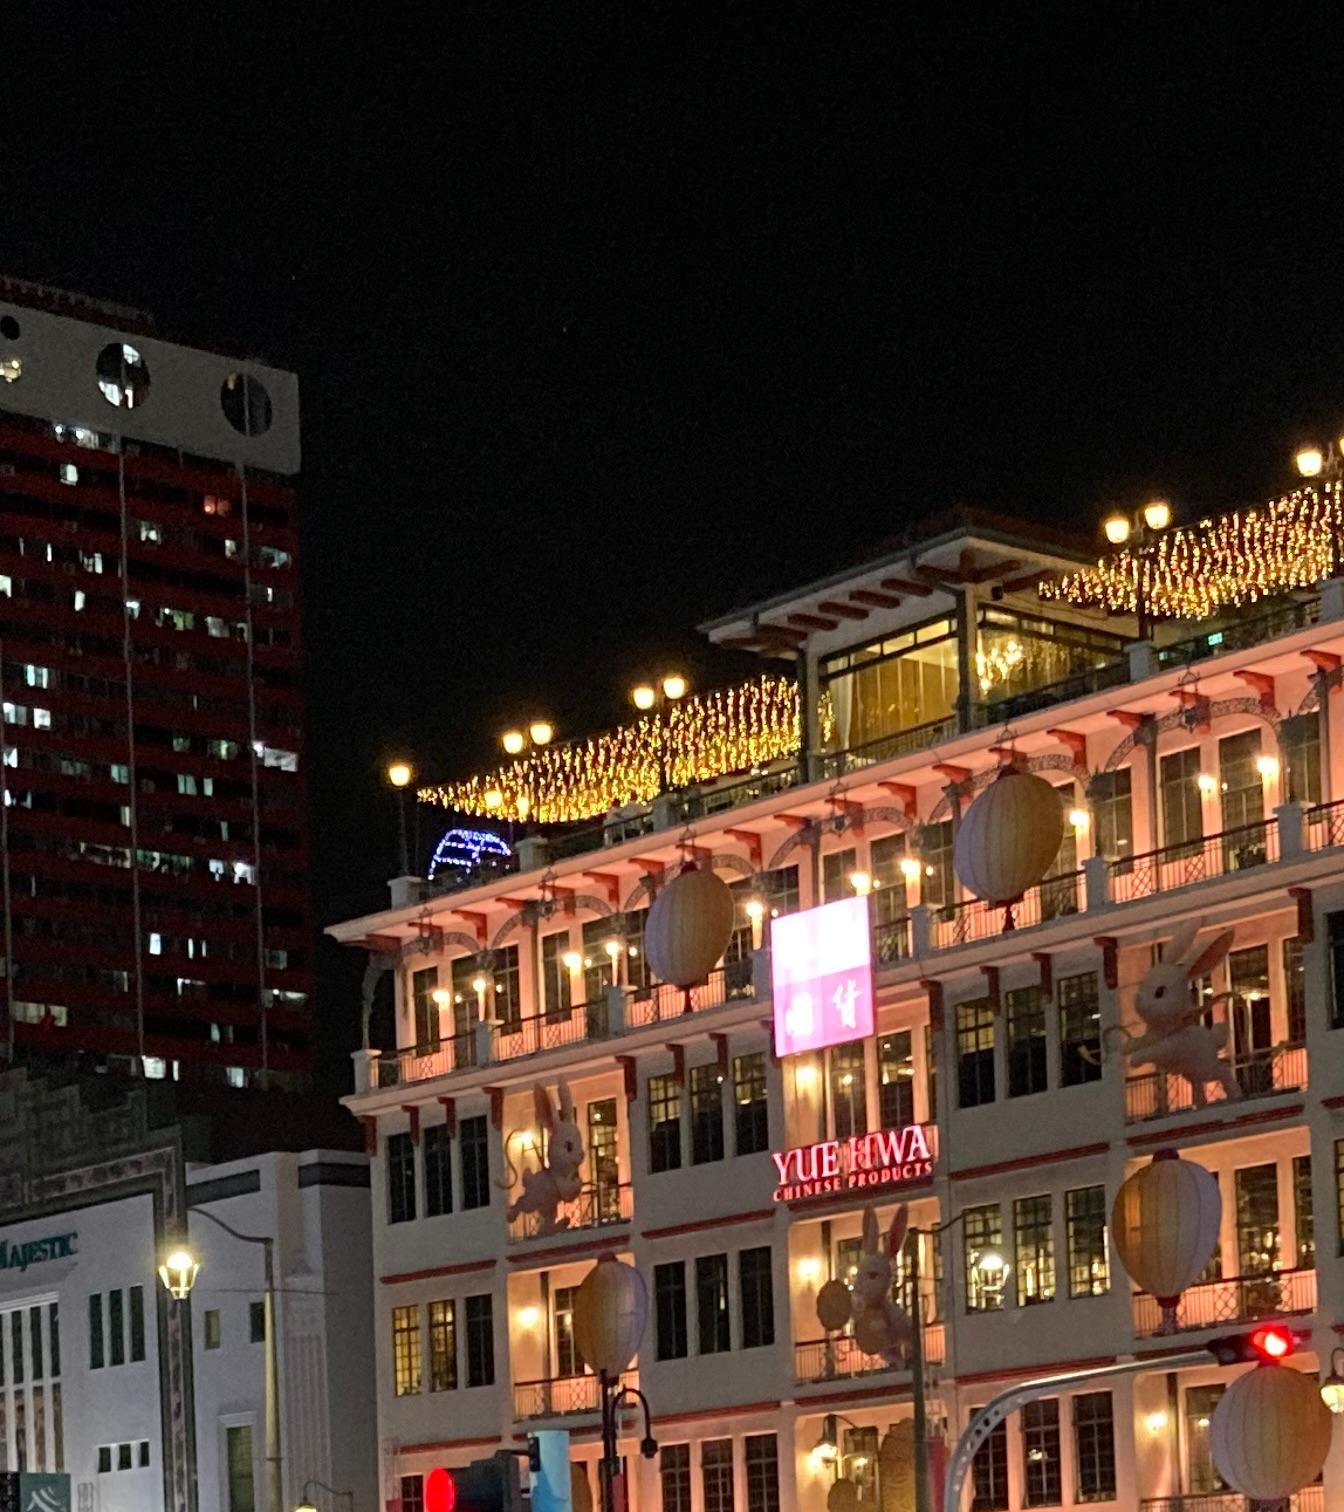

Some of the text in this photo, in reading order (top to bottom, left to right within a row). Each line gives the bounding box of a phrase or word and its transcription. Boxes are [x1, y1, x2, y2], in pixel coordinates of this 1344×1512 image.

[772, 1125, 931, 1186] YUE HWA
[773, 1161, 933, 1201] CHINESE PRODUCTS
